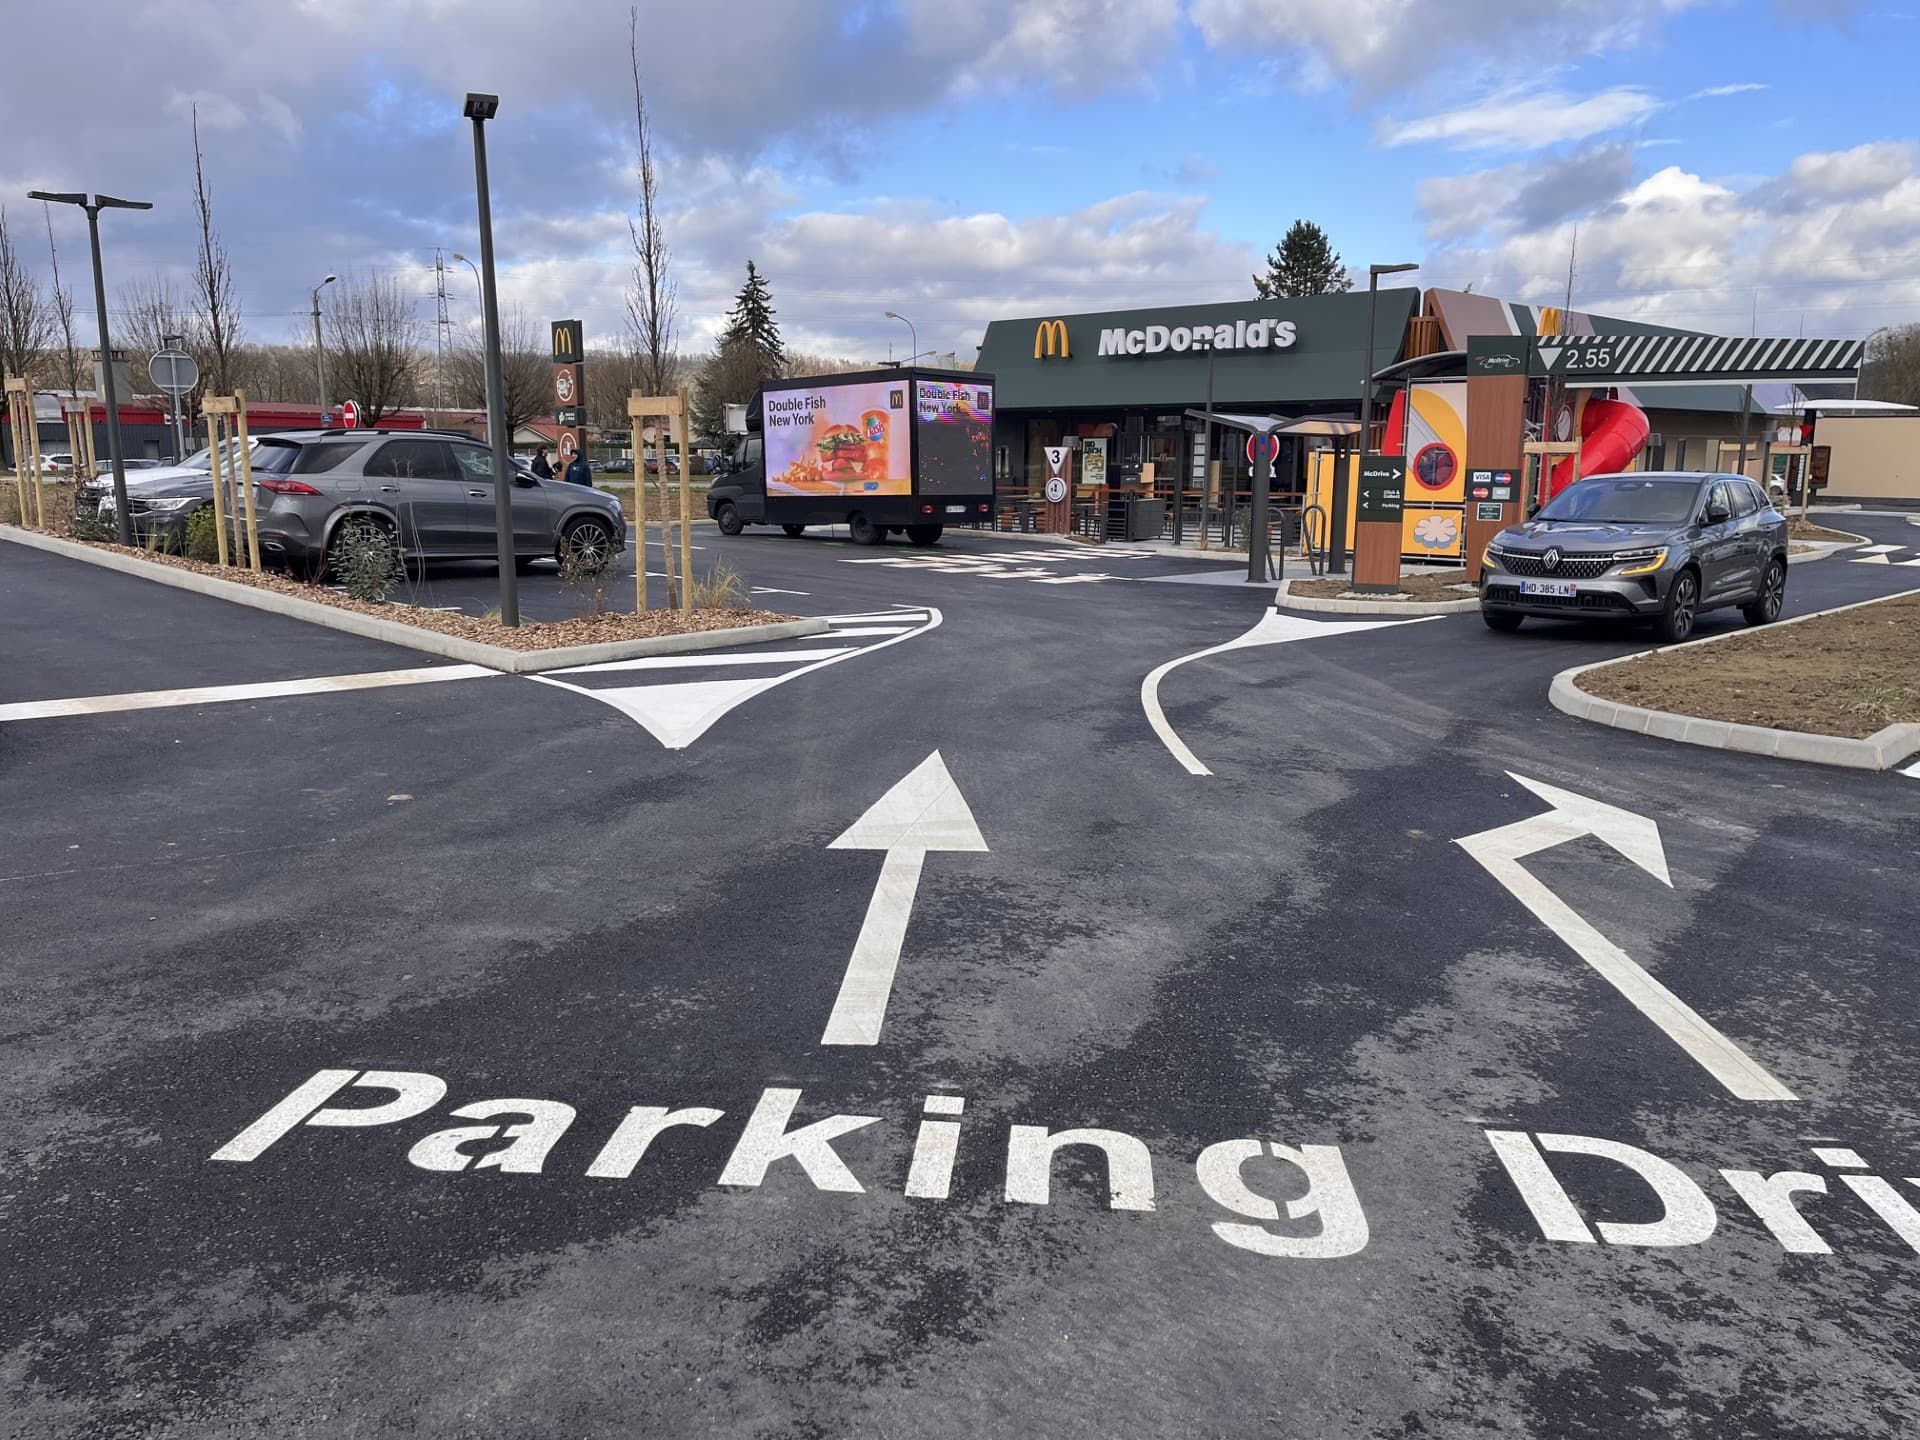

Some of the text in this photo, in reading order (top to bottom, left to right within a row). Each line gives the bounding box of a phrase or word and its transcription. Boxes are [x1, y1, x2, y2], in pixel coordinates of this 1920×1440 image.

[1098, 318, 1297, 356] McDonald's
[1565, 348, 1610, 369] 2.55
[768, 395, 826, 412] Double Fish
[919, 401, 961, 414] New York
[769, 411, 814, 427] New York
[1051, 449, 1061, 464] 3
[210, 1069, 1920, 1259] Parking Dri
